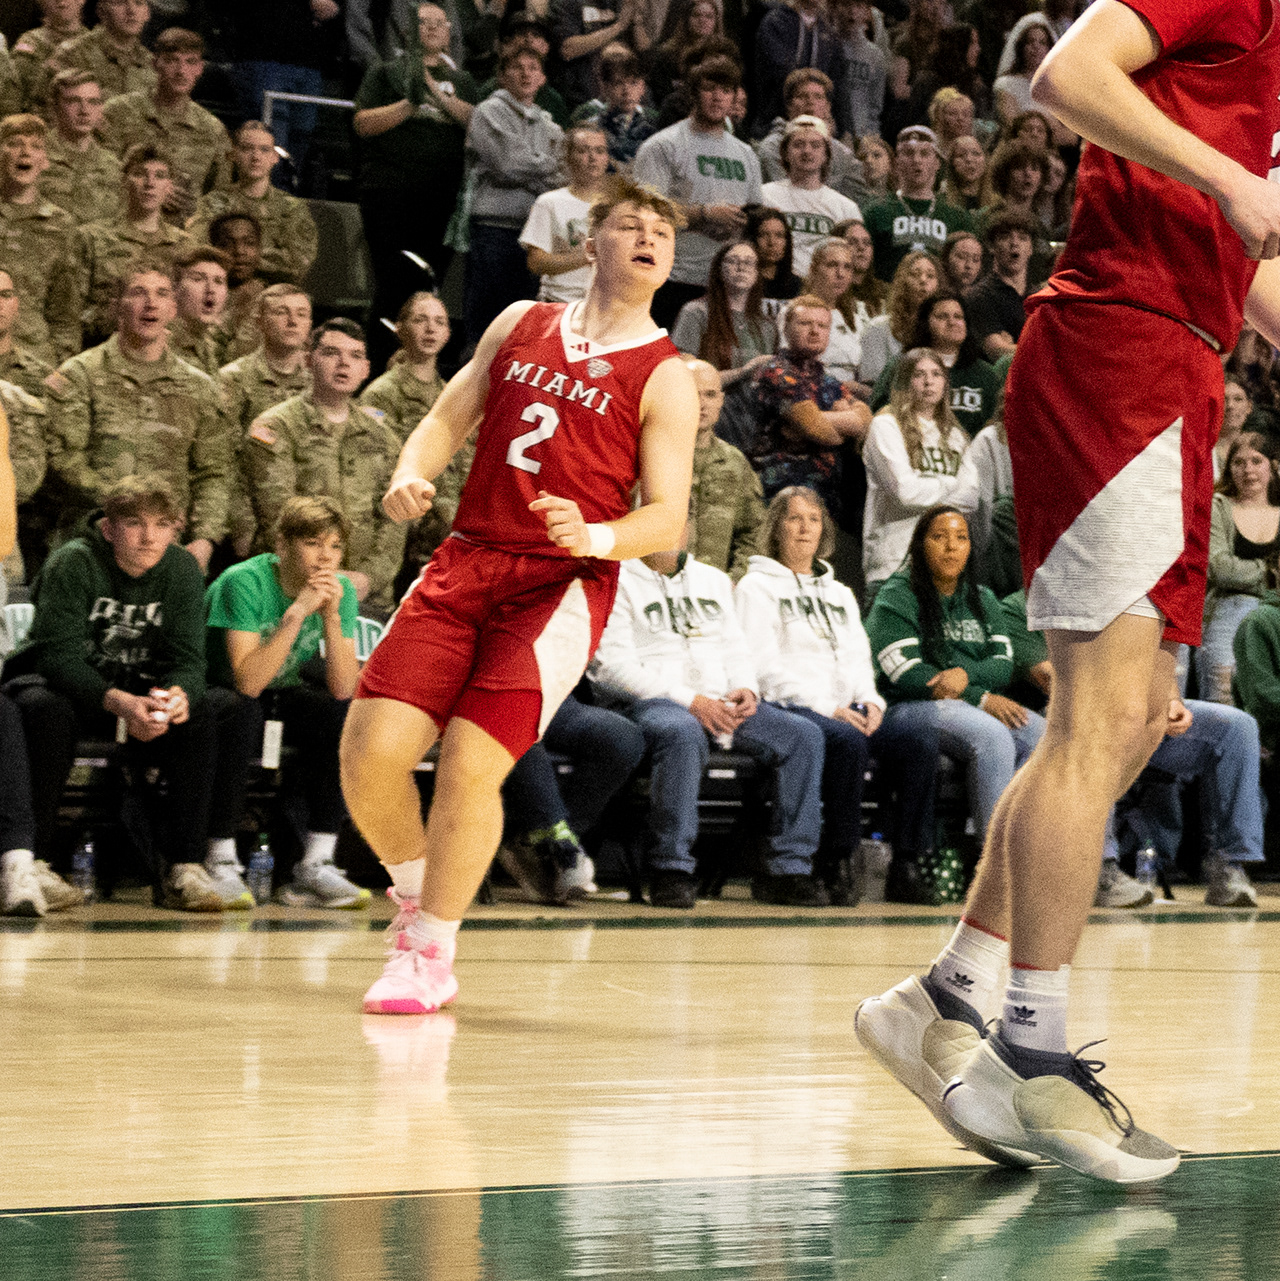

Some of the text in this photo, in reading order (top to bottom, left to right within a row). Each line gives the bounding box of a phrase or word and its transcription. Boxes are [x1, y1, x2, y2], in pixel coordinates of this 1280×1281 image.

[892, 216, 948, 243] OHIO
[504, 360, 612, 416] MIAMI
[505, 401, 560, 475] 2
[644, 599, 721, 635] OHIO
[1009, 1016, 1038, 1028] adidas
